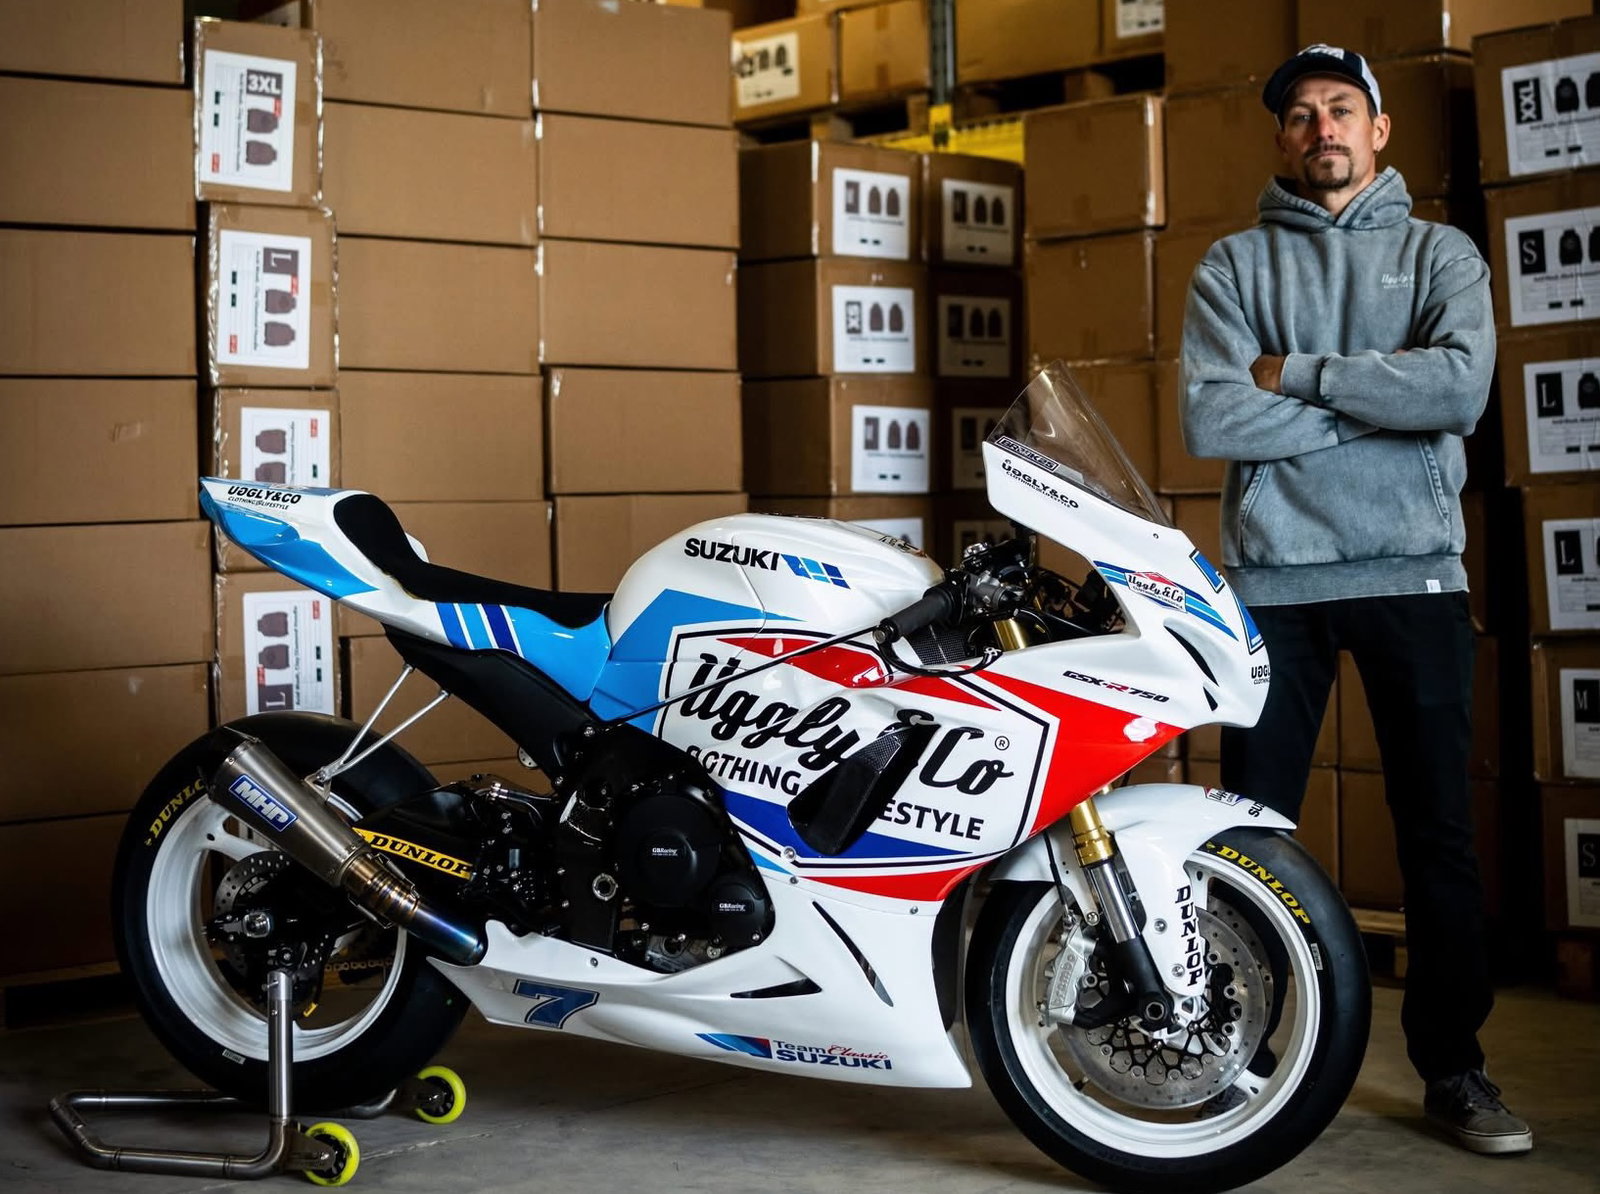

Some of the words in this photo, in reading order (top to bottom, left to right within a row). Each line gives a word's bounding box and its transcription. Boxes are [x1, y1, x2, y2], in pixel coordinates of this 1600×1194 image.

[247, 74, 282, 96] 3XL
[1519, 80, 1536, 121] XXL
[270, 252, 292, 267] L
[1522, 237, 1538, 265] S
[1541, 382, 1556, 408] L
[227, 496, 257, 507] CLOTHING
[684, 537, 780, 571] SUZUKI
[1560, 539, 1576, 566] L
[266, 691, 286, 707] L
[680, 653, 861, 771] Uggly
[1575, 689, 1589, 711] M
[150, 778, 205, 838] DUNLO
[235, 780, 289, 823] MHP
[371, 834, 474, 876] DUNLOP
[1582, 842, 1597, 867] S
[1216, 844, 1312, 925] DUNLOP
[1174, 884, 1202, 987] DUNLOP
[512, 978, 601, 1030] 7
[772, 1039, 827, 1054] Team
[825, 1044, 889, 1060] Classic
[776, 1049, 893, 1071] SUZUKI
